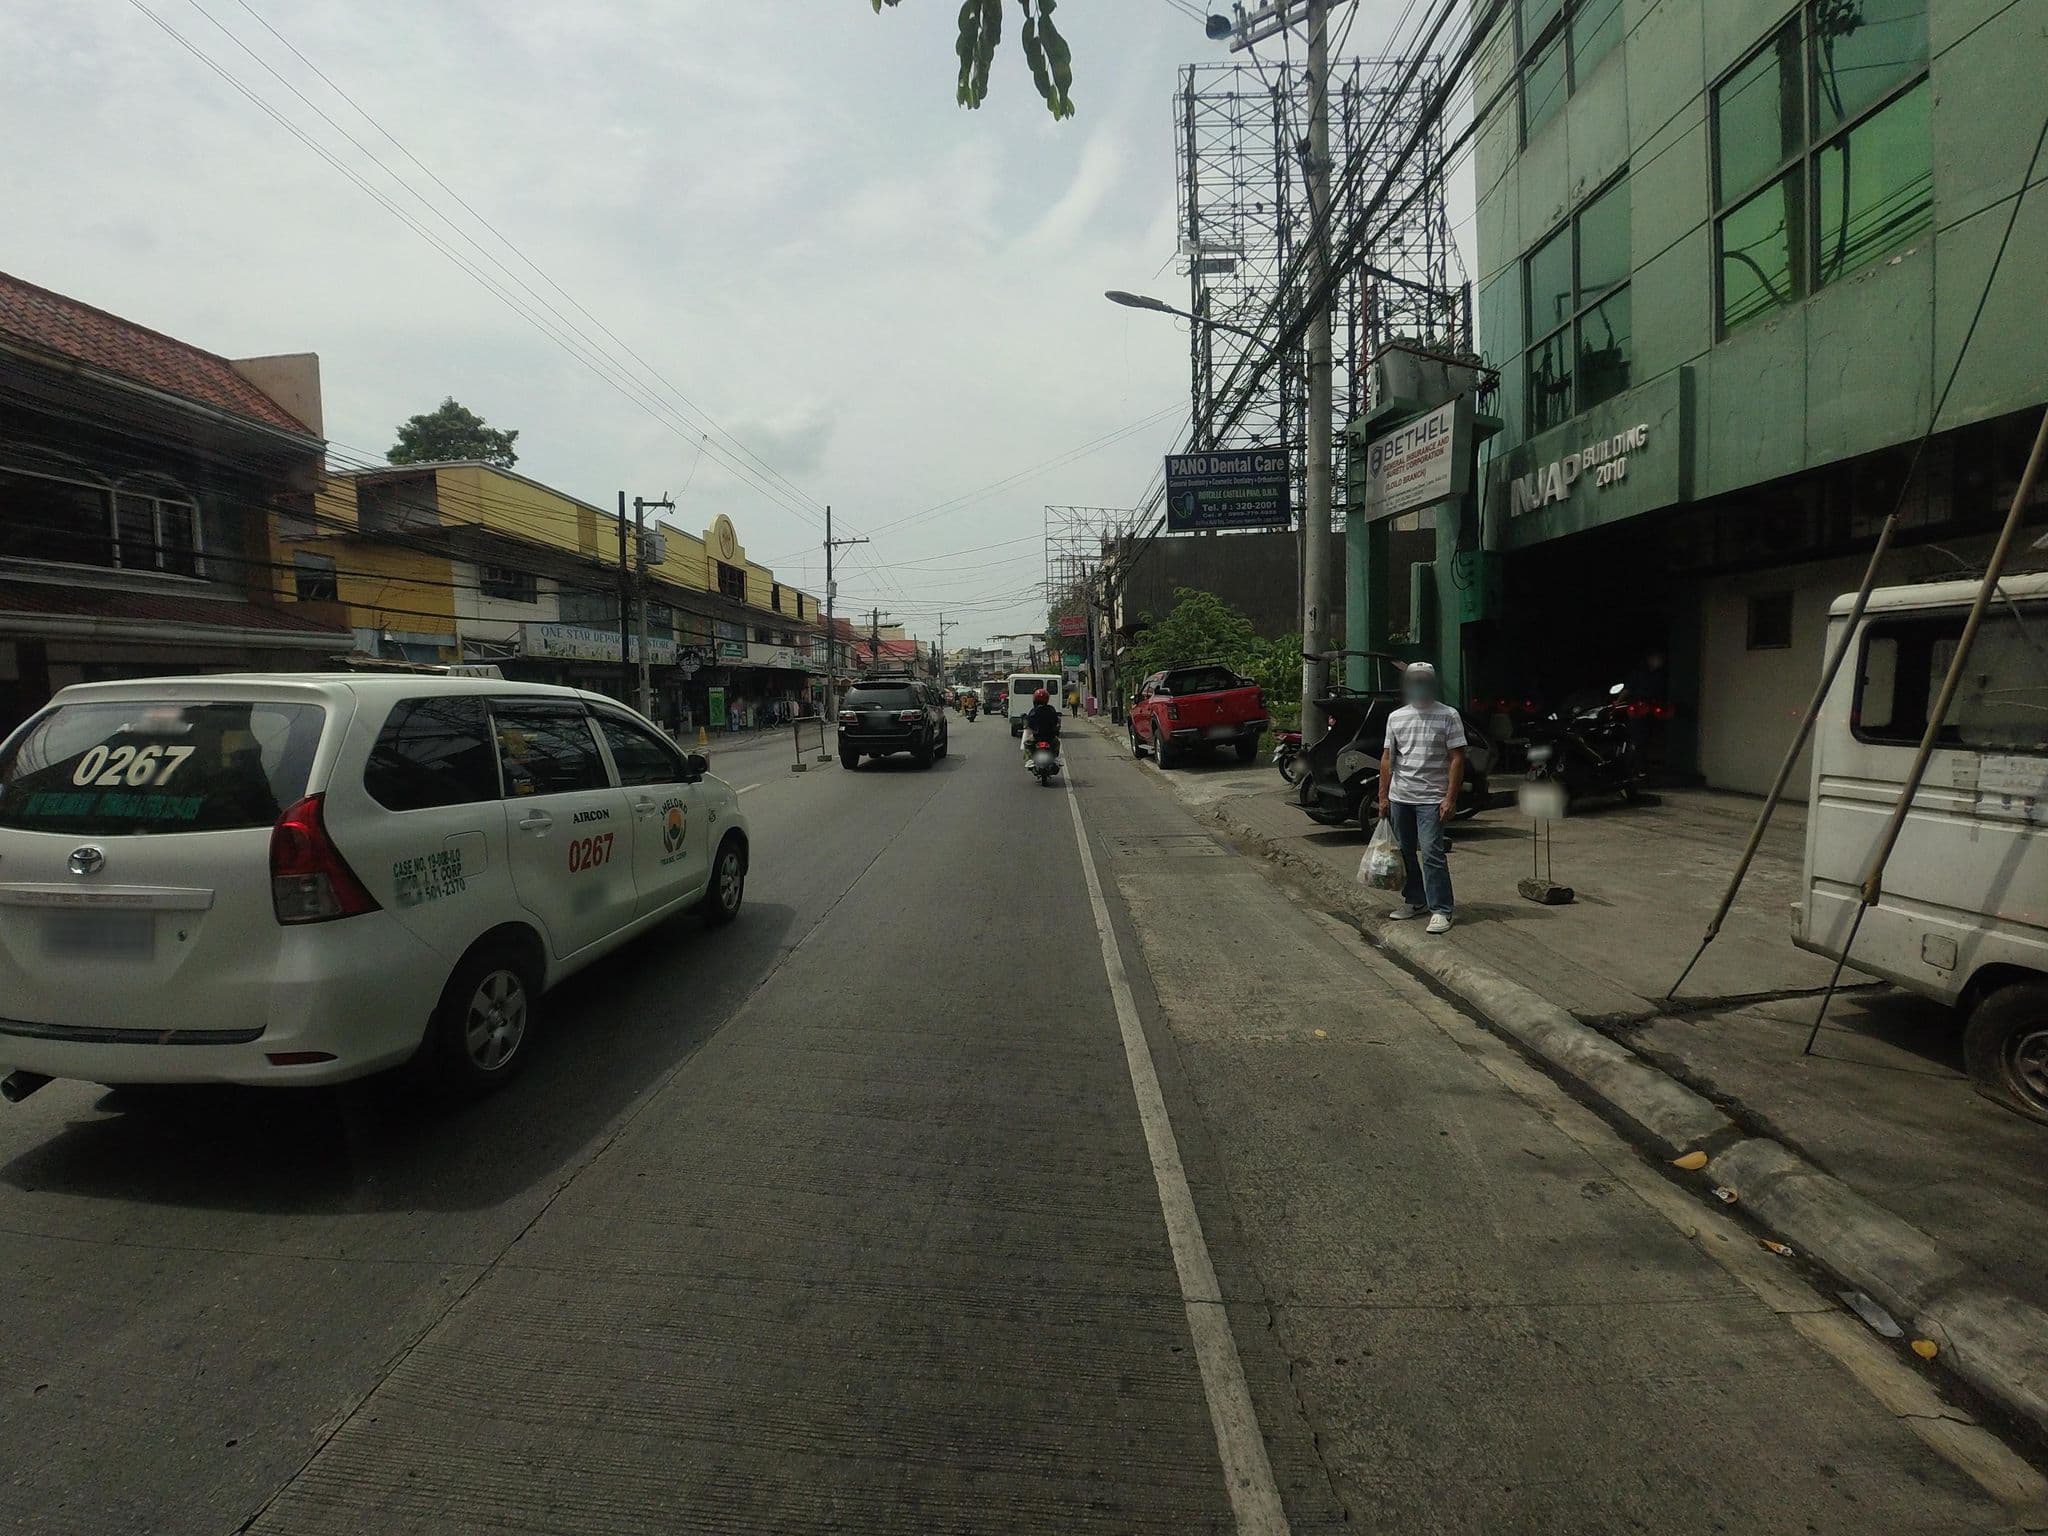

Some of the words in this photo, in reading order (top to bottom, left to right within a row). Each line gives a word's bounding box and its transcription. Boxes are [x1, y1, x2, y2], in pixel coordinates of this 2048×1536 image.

[1384, 413, 1449, 461] BETHEL
[1438, 435, 1450, 447] AND
[1582, 424, 1649, 470] BUILDING
[1171, 457, 1207, 475] PANO
[1210, 456, 1251, 474] Dental
[1254, 455, 1284, 472] Care
[1596, 457, 1628, 487] 2010
[1202, 504, 1219, 512] Tel.
[1236, 501, 1277, 510] 320-2001
[541, 626, 562, 639] ONE
[566, 629, 590, 641] STAR
[72, 745, 196, 786] 0267
[573, 808, 610, 824] AIRCON
[568, 832, 614, 873] 0267
[393, 860, 412, 878] CASE
[441, 863, 462, 881] CORP
